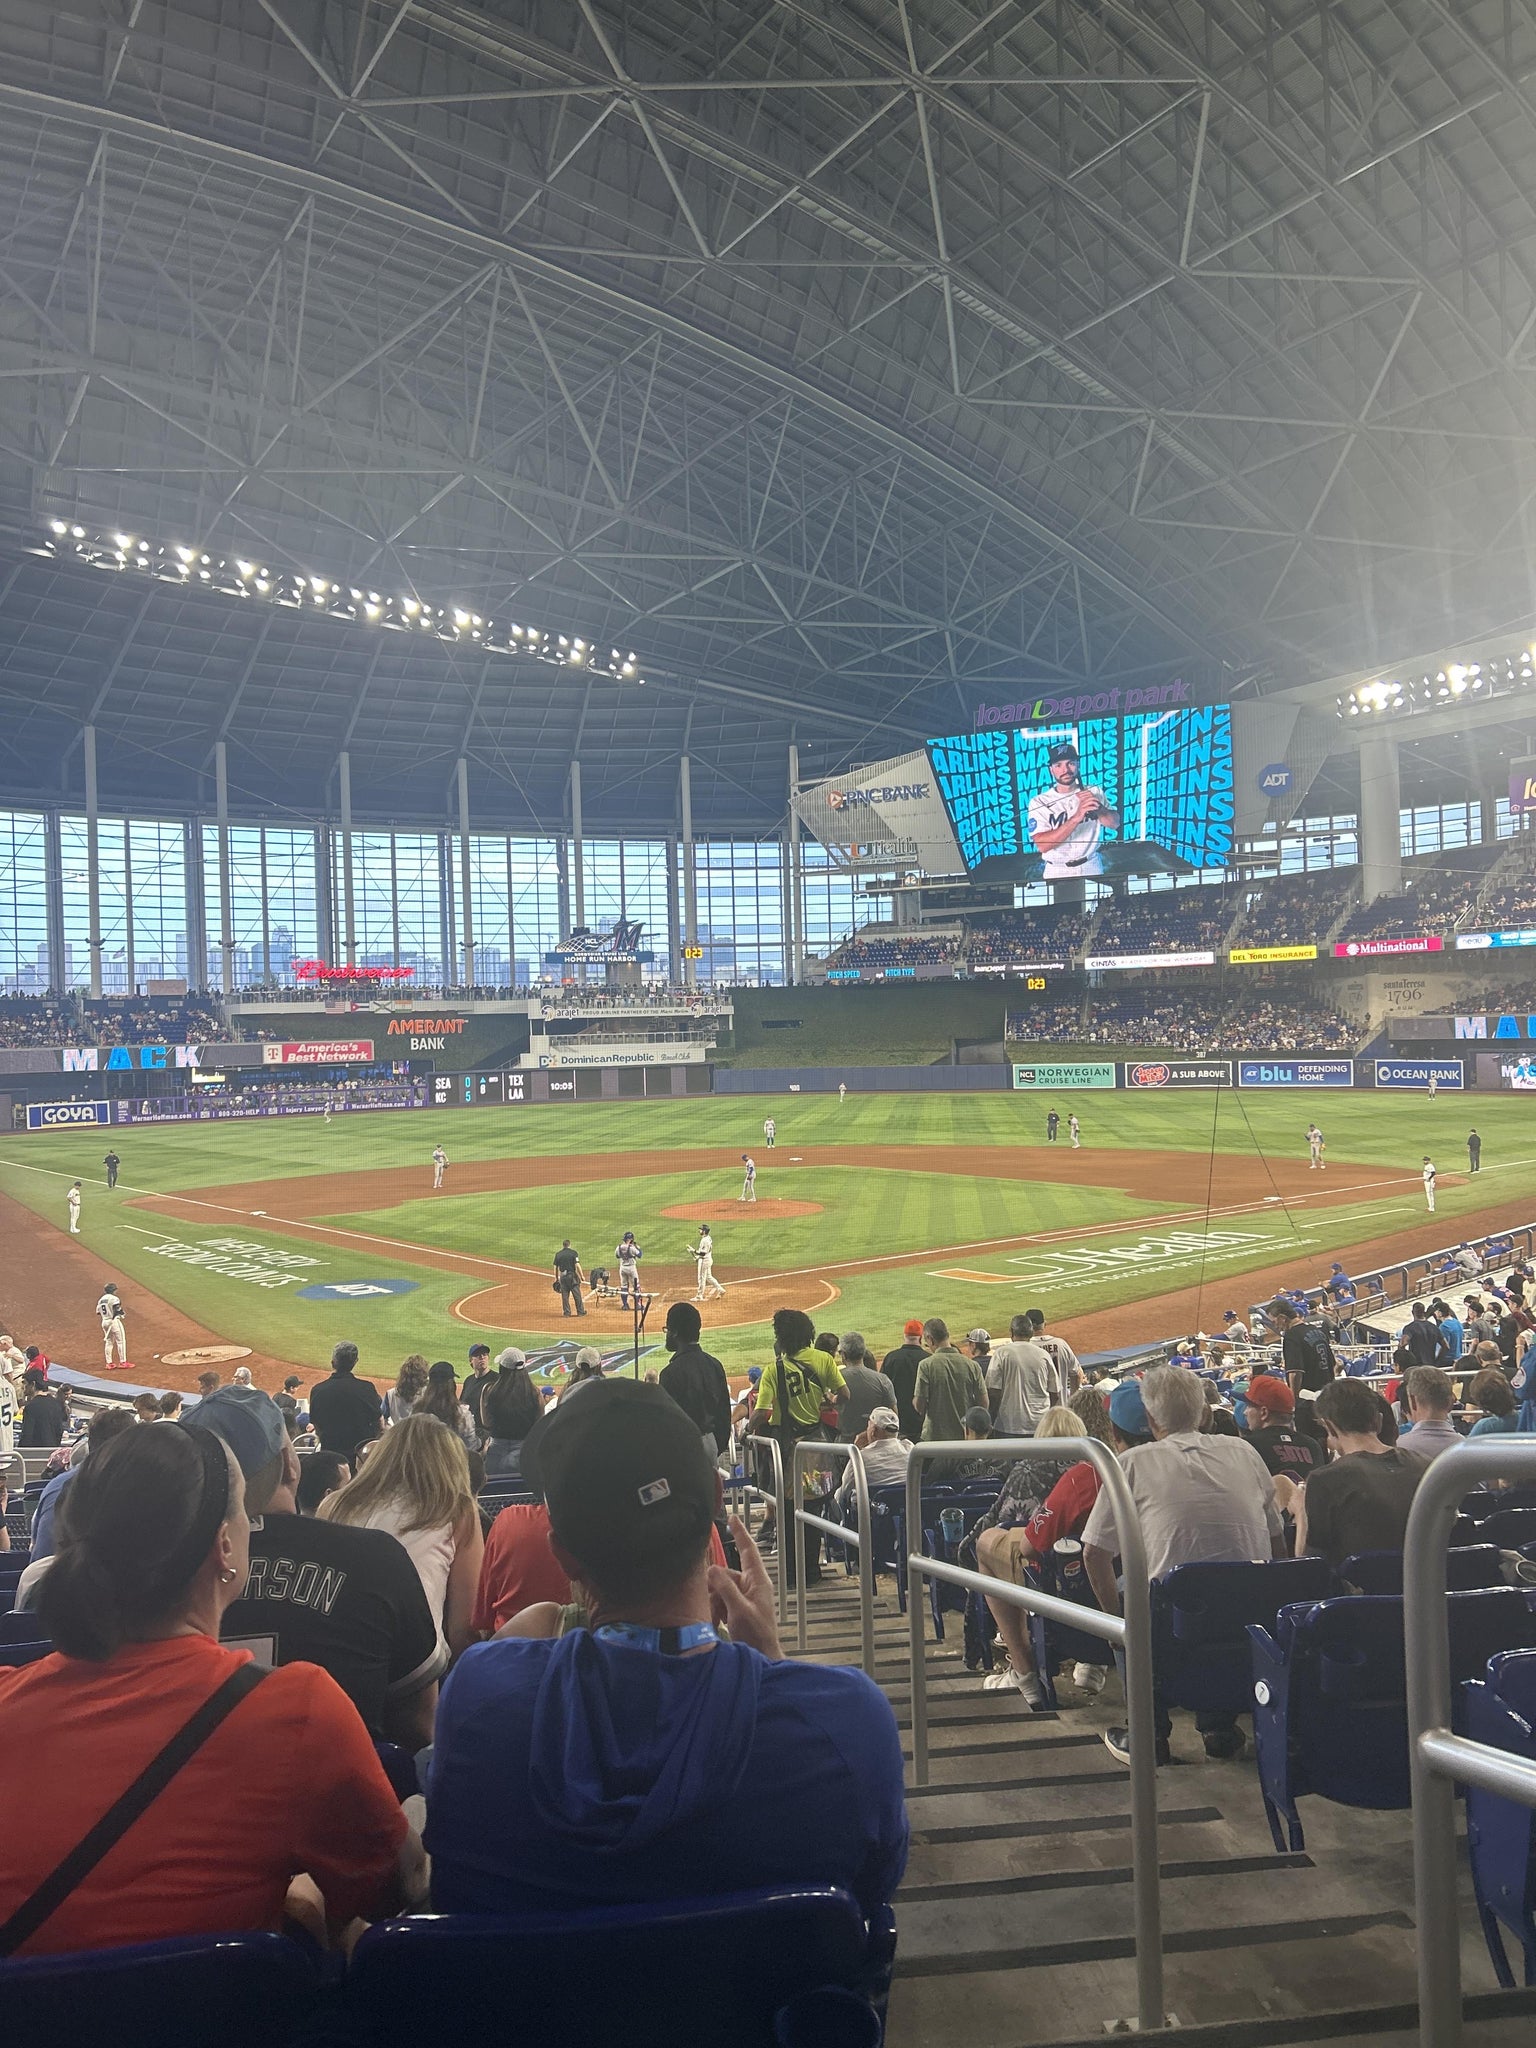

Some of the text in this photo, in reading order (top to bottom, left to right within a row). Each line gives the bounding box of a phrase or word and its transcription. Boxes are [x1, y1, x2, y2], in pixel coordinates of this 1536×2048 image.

[977, 687, 1121, 727] loanDepot
[1123, 678, 1190, 713] park
[1262, 772, 1289, 787] ADT
[1124, 791, 1235, 823] MARLINS
[1360, 939, 1428, 954] Multinational
[1248, 952, 1268, 960] TORO
[1270, 950, 1314, 959] INSURANCE
[974, 964, 1006, 972] loanDepot
[1091, 959, 1116, 967] CINTAS
[291, 960, 415, 981] Budweiser
[827, 970, 860, 978] PITCH SPEED
[885, 969, 900, 977] PITCH
[901, 968, 915, 976] TYPE
[557, 1008, 579, 1018] arajet
[704, 1006, 722, 1016] arajet
[387, 1018, 465, 1034] AMERANT
[297, 1043, 359, 1053] America's
[410, 1037, 446, 1051] BANK
[63, 1046, 201, 1072] MACK
[287, 1051, 369, 1062] Best Network
[1038, 1068, 1110, 1077] NORWEGIAN
[1198, 1070, 1226, 1078] ABOVE
[1260, 1066, 1292, 1081] blu
[1298, 1065, 1348, 1073] DEFENDING
[1393, 1069, 1460, 1080] OCEAN BANK
[435, 1077, 451, 1090] SEA
[465, 1076, 471, 1088] 0
[508, 1074, 524, 1086] TEX
[551, 1082, 573, 1091] 10:05
[435, 1092, 447, 1104] KC
[465, 1091, 471, 1102] 5
[508, 1088, 524, 1100] LAA
[44, 1106, 94, 1123] GOYA
[324, 1283, 394, 1296] ADT
